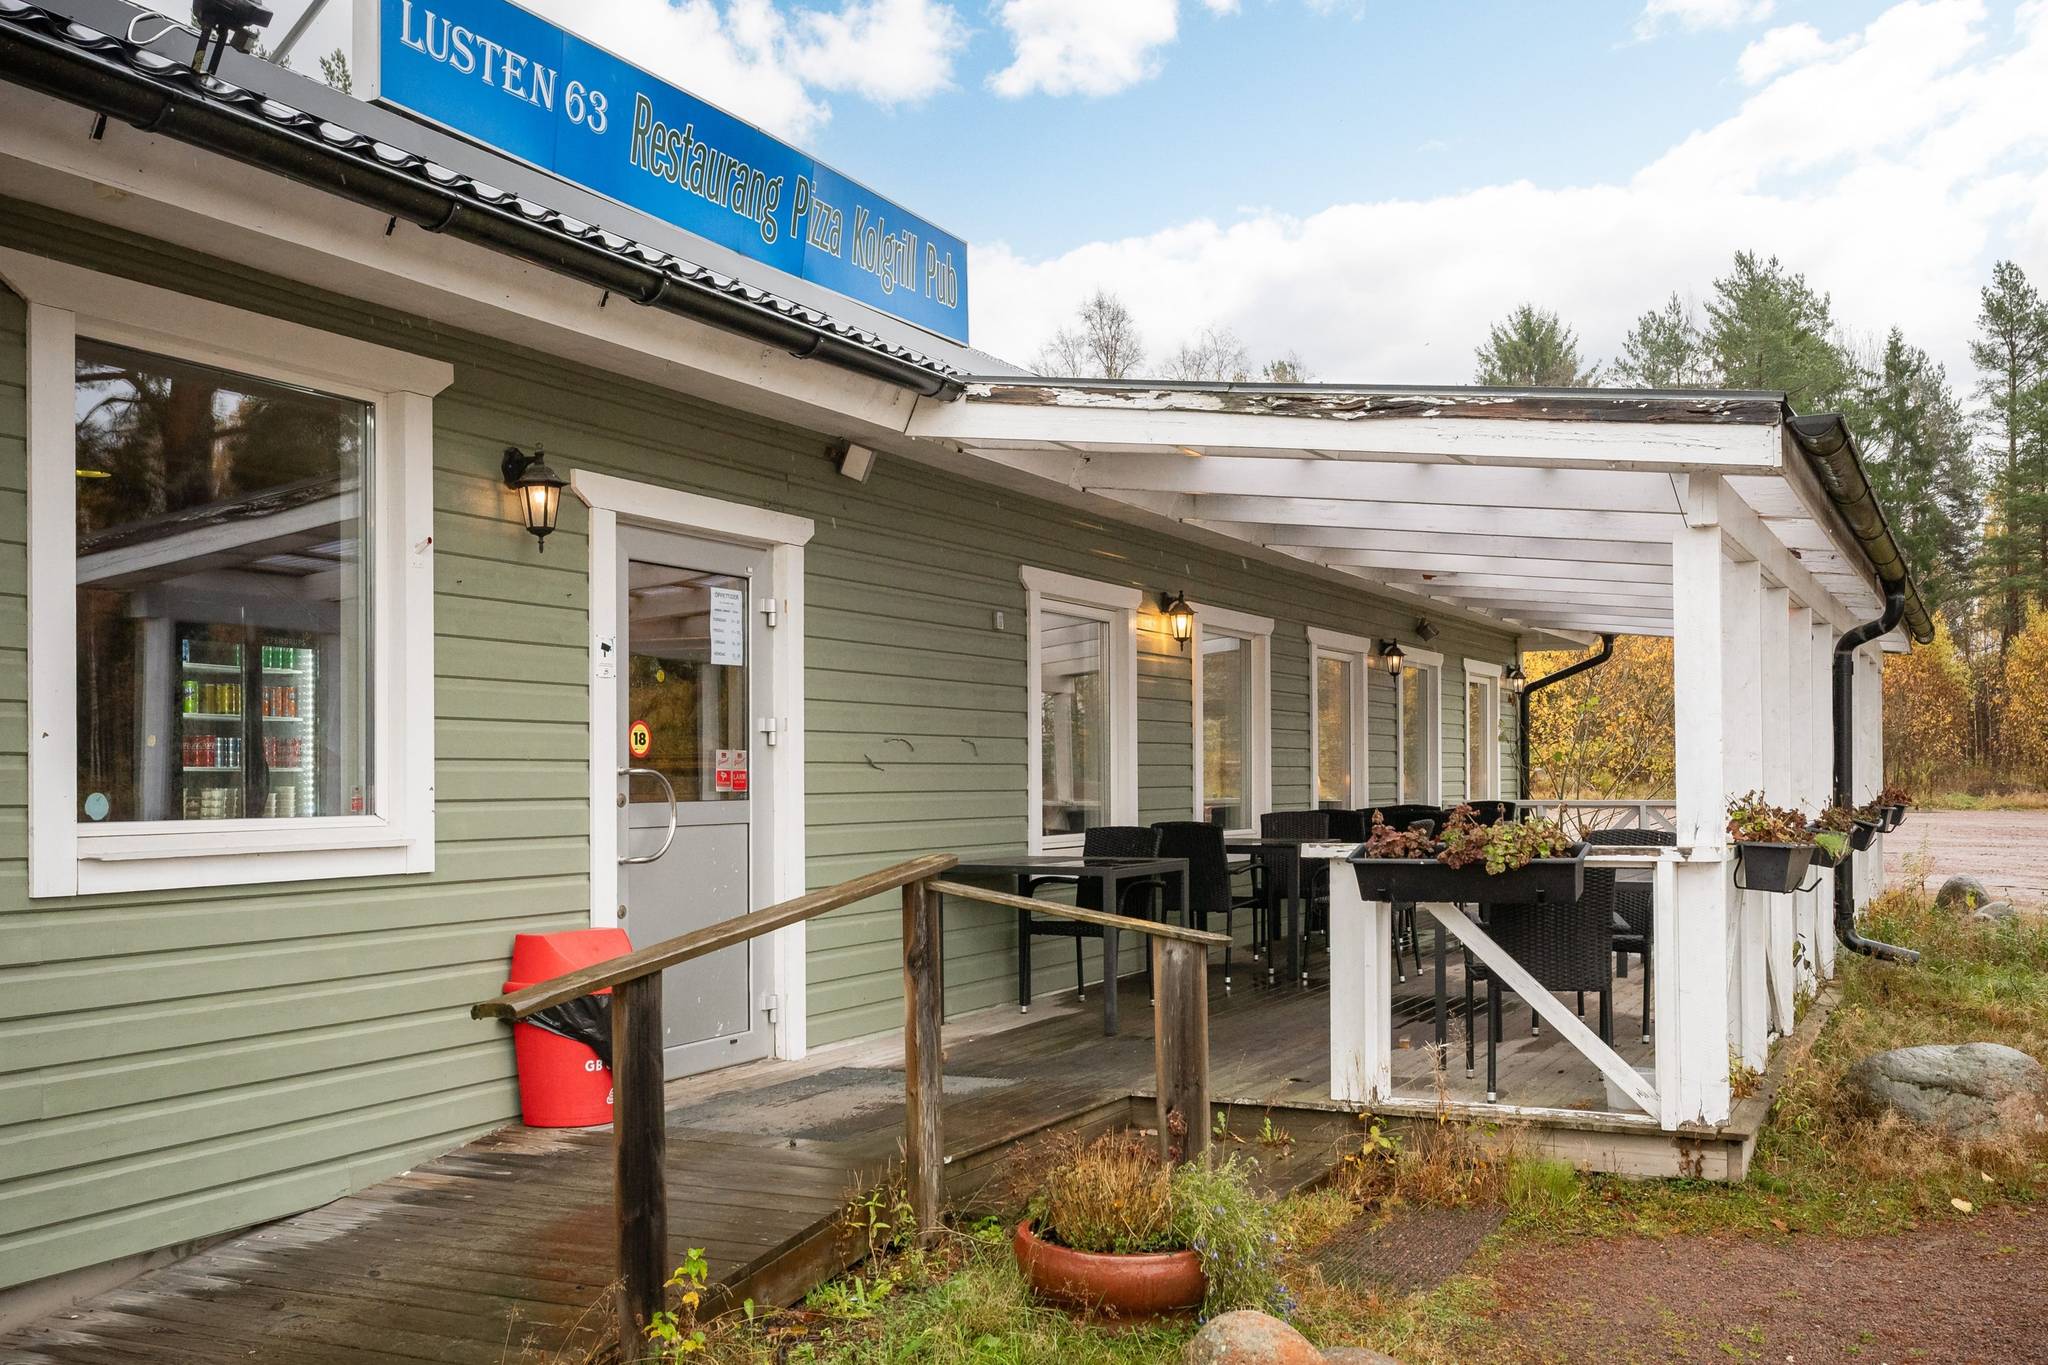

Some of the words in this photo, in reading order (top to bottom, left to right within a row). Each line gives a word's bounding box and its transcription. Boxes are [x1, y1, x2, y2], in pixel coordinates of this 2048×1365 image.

[400, 0, 558, 112] LUSTEN
[565, 80, 608, 135] 63
[630, 92, 783, 244] Restaurang
[790, 174, 843, 258] Pizza
[852, 205, 917, 295] Kolgrill
[925, 242, 958, 309] Pub
[633, 732, 646, 746] 18
[585, 1059, 603, 1072] GB
